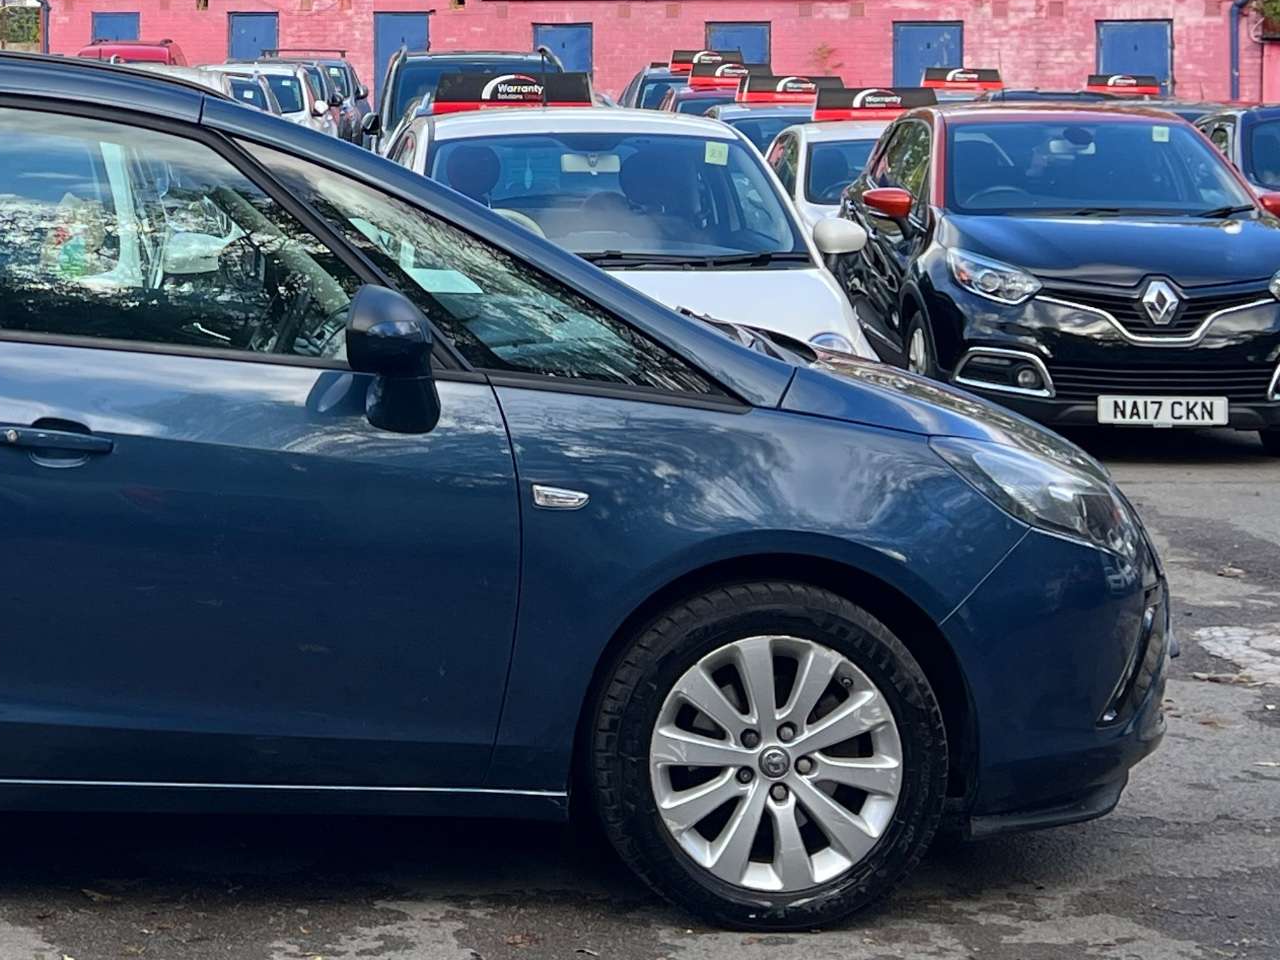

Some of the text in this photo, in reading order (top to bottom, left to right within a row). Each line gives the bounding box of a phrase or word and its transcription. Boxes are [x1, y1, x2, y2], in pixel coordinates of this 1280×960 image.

[497, 84, 543, 94] Warranty
[1113, 400, 1214, 421] NA17 CKN
